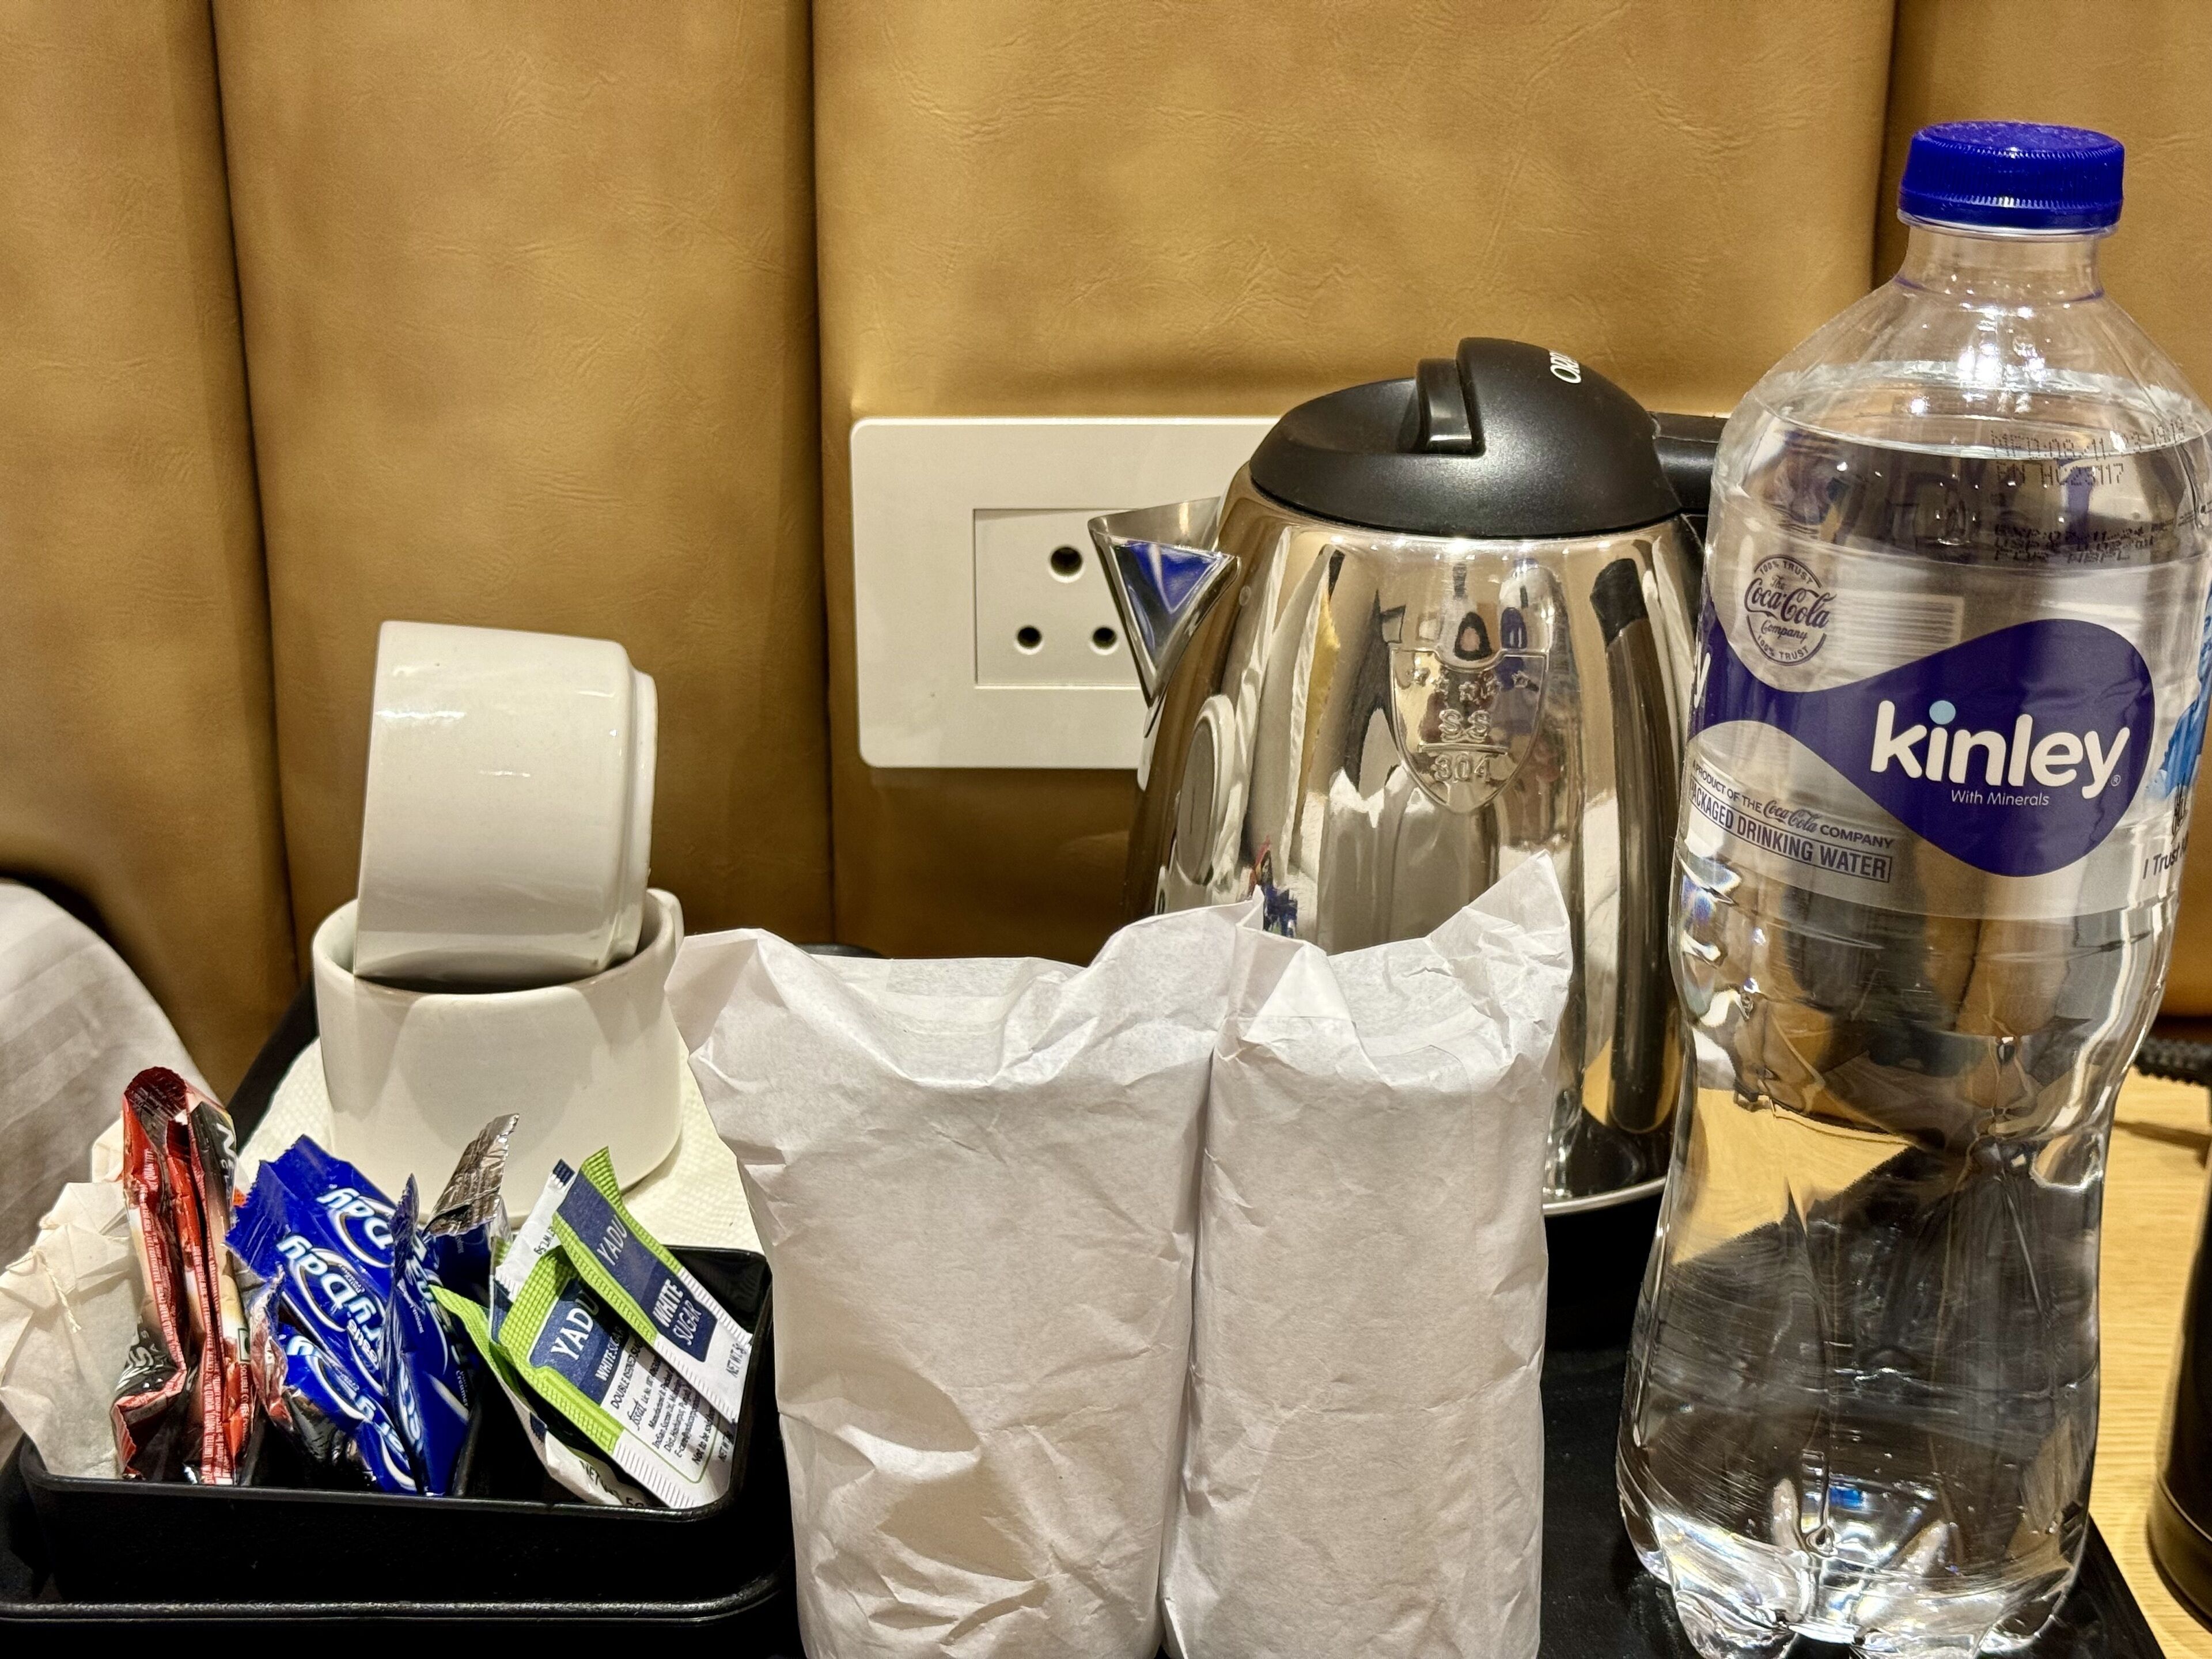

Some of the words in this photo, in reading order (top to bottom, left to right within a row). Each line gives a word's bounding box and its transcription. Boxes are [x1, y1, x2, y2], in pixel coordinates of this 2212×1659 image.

[1782, 560, 1814, 585] TRUST
[1760, 619, 1809, 644] Company
[1778, 645, 1810, 660] TRUST
[1870, 700, 2130, 800] kinley
[1695, 764, 1727, 794] PRODUCT
[1726, 787, 1740, 801] OF
[1741, 794, 1763, 813] THE
[1819, 824, 1895, 849] COMPANY
[1950, 789, 1984, 805] With
[1987, 791, 2050, 806] Minerals
[1690, 779, 1734, 830] PACKAGED
[1737, 816, 1814, 862] DRINKING
[1819, 844, 1886, 880] WATER
[2153, 849, 2180, 873] Trust
[596, 1213, 628, 1266] YADU
[551, 1289, 600, 1361] YADU
[652, 1278, 684, 1328] WHITE
[672, 1299, 703, 1346] SUGAR
[594, 1347, 616, 1382] WHITE
[608, 1325, 625, 1355] SUGAR
[611, 1377, 630, 1410] DOUBLE
[630, 1342, 644, 1358] SUG
[691, 1448, 703, 1466] Not
[698, 1439, 707, 1451] to
[700, 1429, 710, 1441] be
